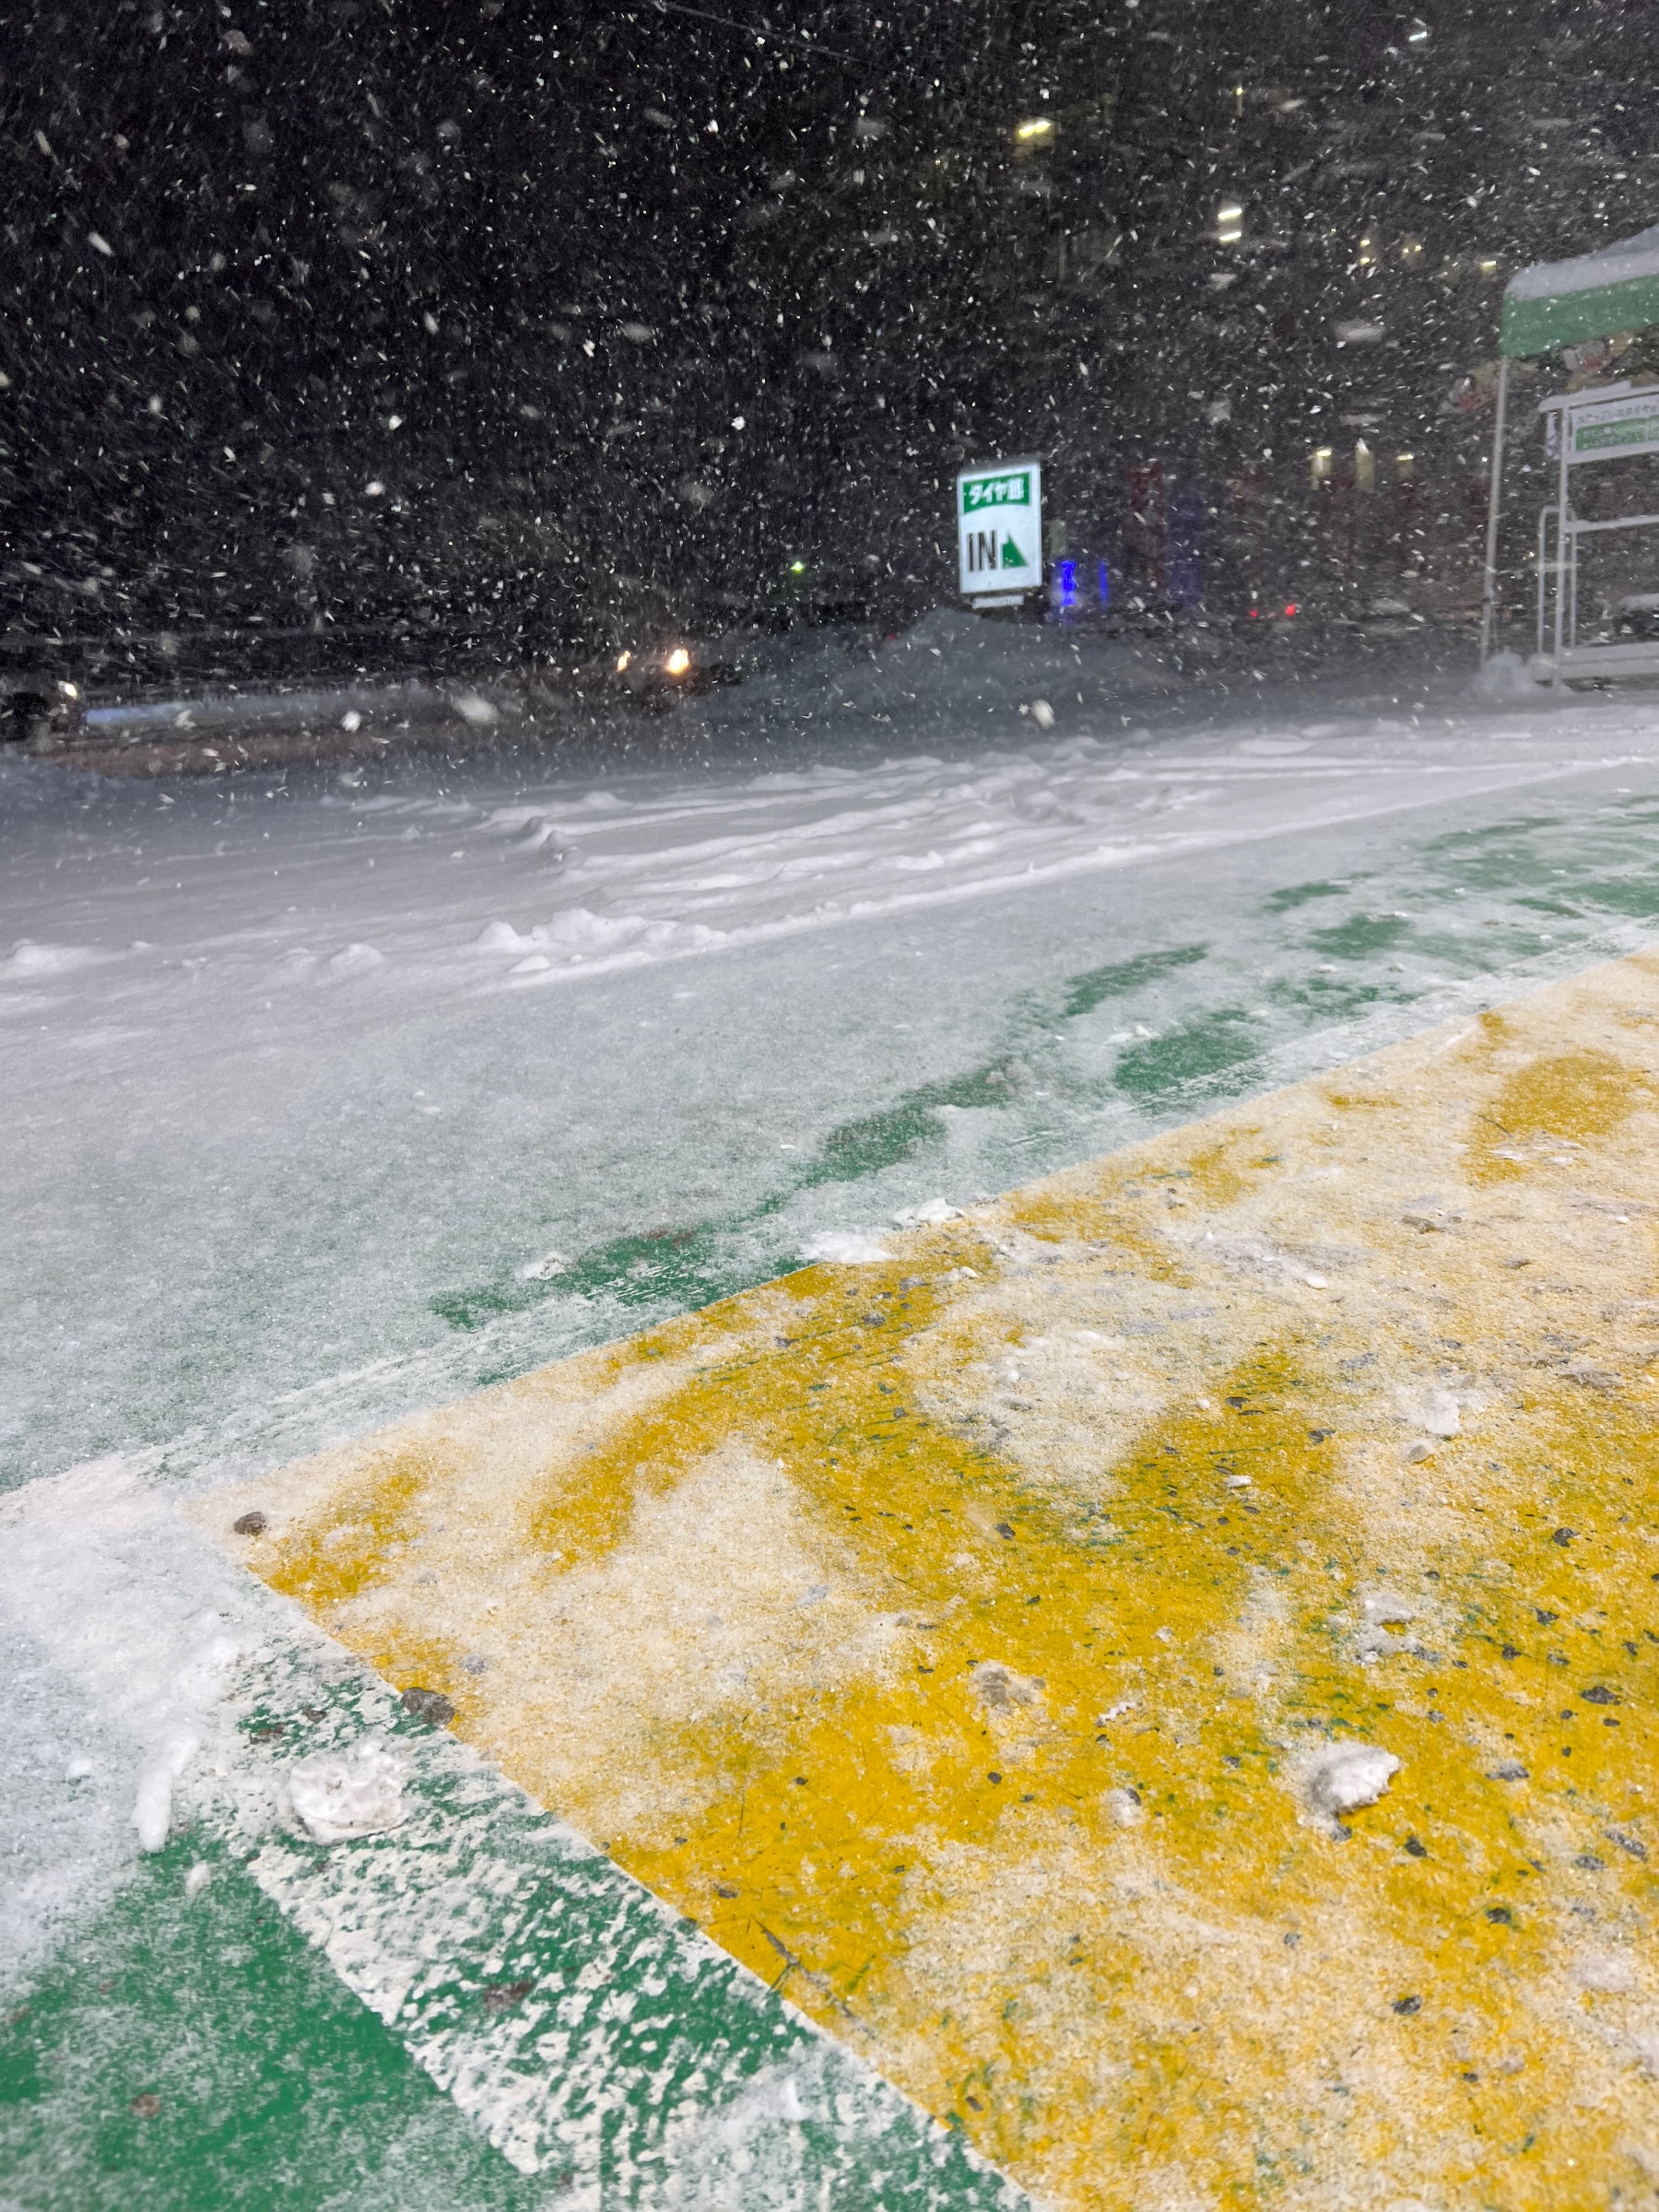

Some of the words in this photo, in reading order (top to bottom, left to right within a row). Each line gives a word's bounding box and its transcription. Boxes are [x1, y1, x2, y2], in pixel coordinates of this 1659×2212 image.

[969, 477, 1024, 506] タイヤ館
[969, 530, 996, 571] IN
